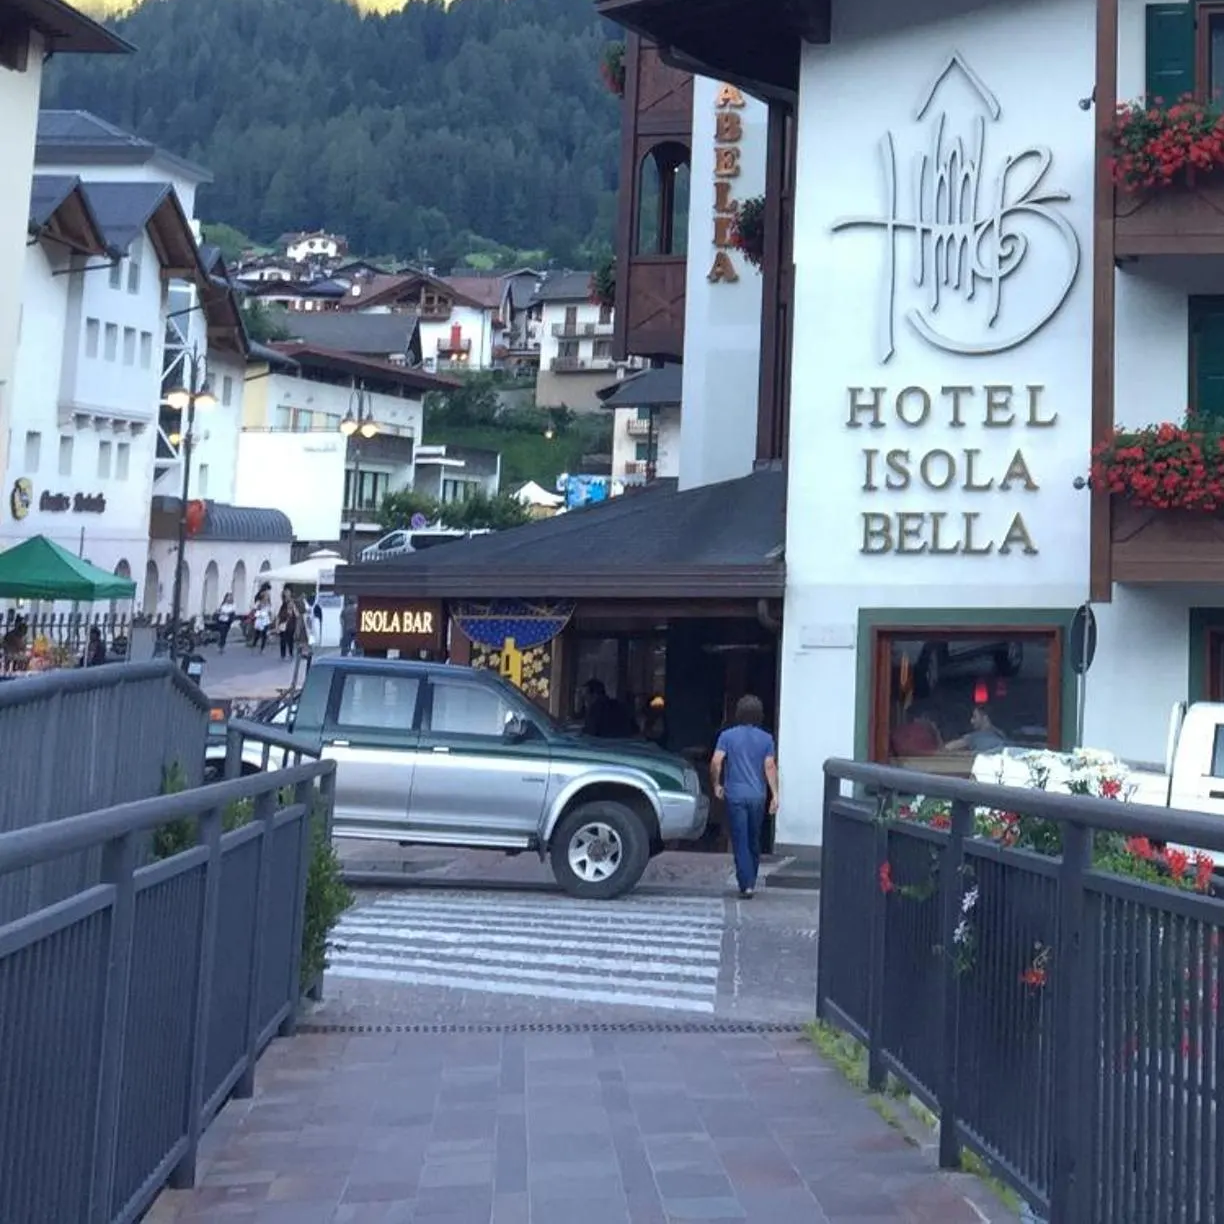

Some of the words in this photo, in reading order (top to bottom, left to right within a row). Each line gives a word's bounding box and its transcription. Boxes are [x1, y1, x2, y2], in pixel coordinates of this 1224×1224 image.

[846, 385, 1059, 428] HOTEL
[861, 448, 1040, 492] ISOLA
[860, 511, 1040, 555] BELLA
[360, 610, 400, 633] ISOLA
[403, 611, 433, 633] BAR
